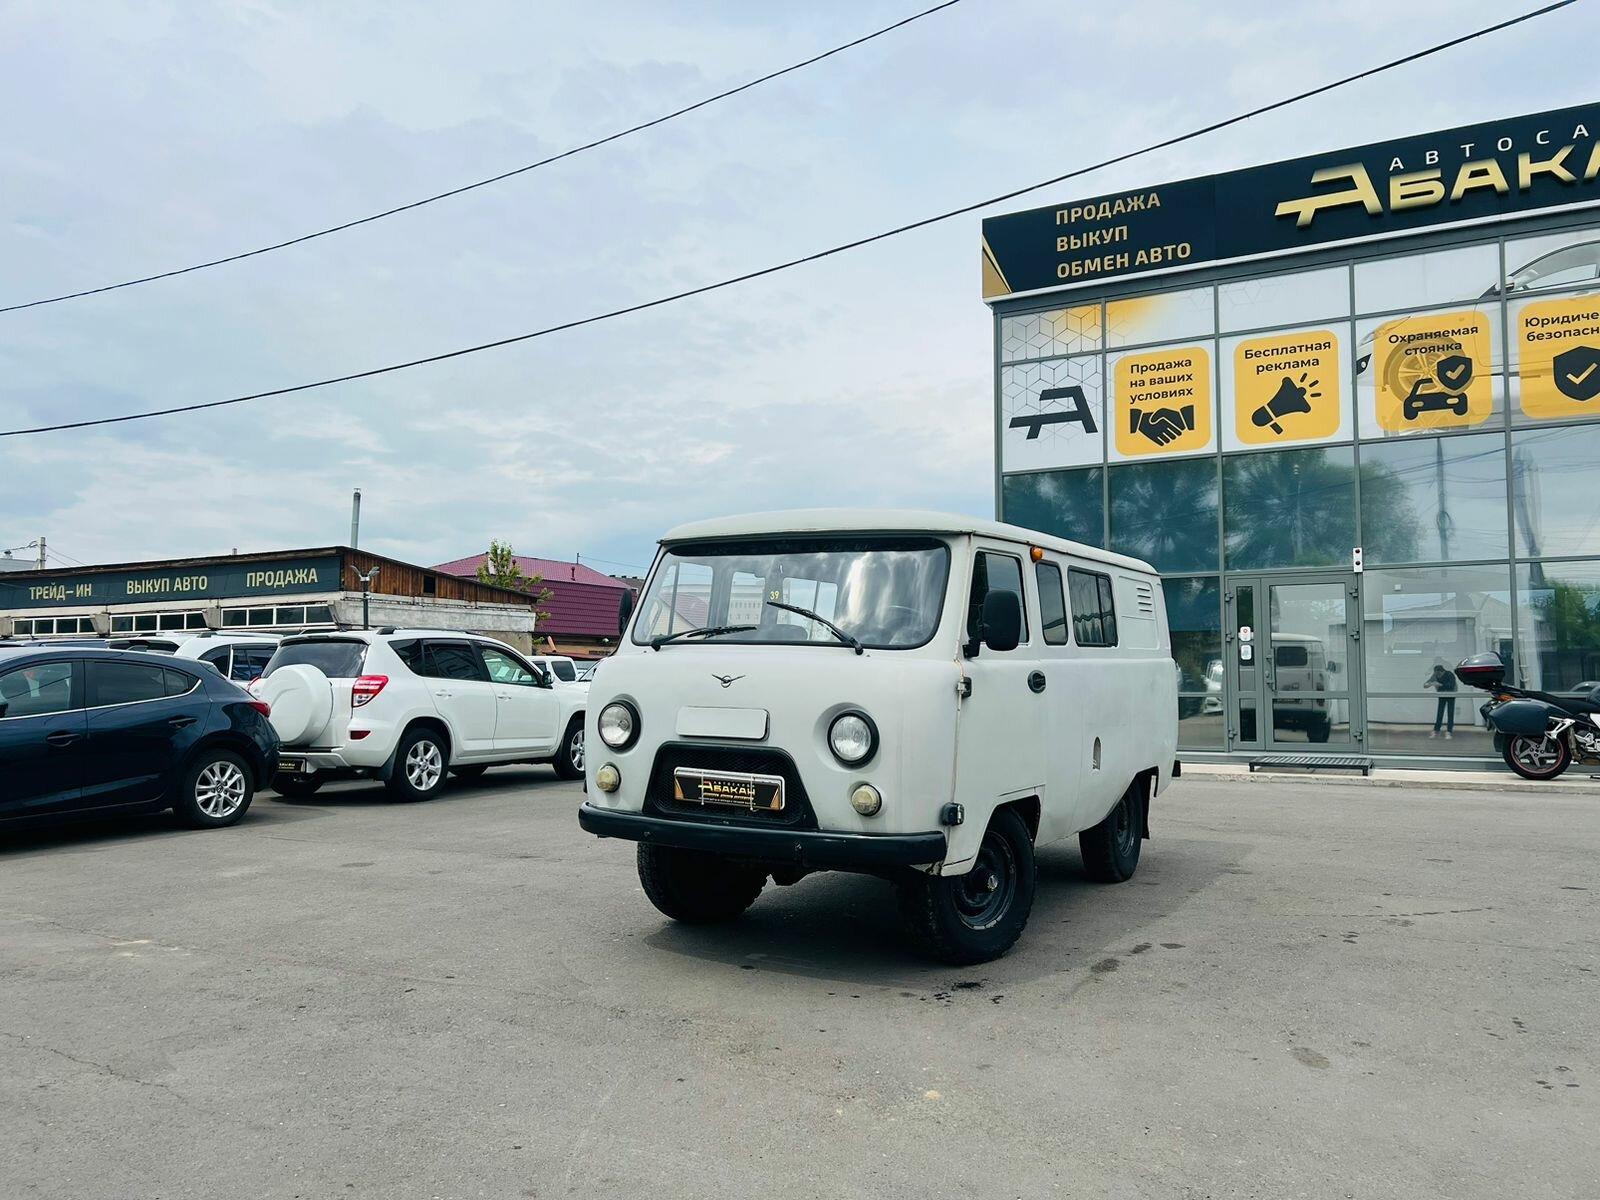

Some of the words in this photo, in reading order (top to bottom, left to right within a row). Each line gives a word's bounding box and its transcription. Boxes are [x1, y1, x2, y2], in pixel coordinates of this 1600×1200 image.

[1056, 192, 1161, 225] ПРОДАЖА
[1056, 225, 1128, 252] ВЫКУП
[1057, 252, 1129, 278] ОБМЕН
[1135, 242, 1191, 266] АВТО
[1525, 311, 1600, 328] Юридиче
[1388, 325, 1479, 344] Охраняемая
[1526, 326, 1600, 342] безопасн
[1244, 341, 1331, 360] Бесплатная
[1404, 341, 1462, 356] стоянка
[1130, 357, 1192, 374] Продажа
[1256, 356, 1320, 375] реклама
[1130, 378, 1146, 388] на
[1149, 373, 1193, 386] ваших
[1130, 387, 1193, 404] условиях
[126, 577, 170, 595] ВЫКУП
[174, 575, 208, 592] АВТО
[246, 568, 319, 588] ПРОДАЖА
[769, 590, 780, 600] 39
[698, 780, 756, 797] АБАКАН
